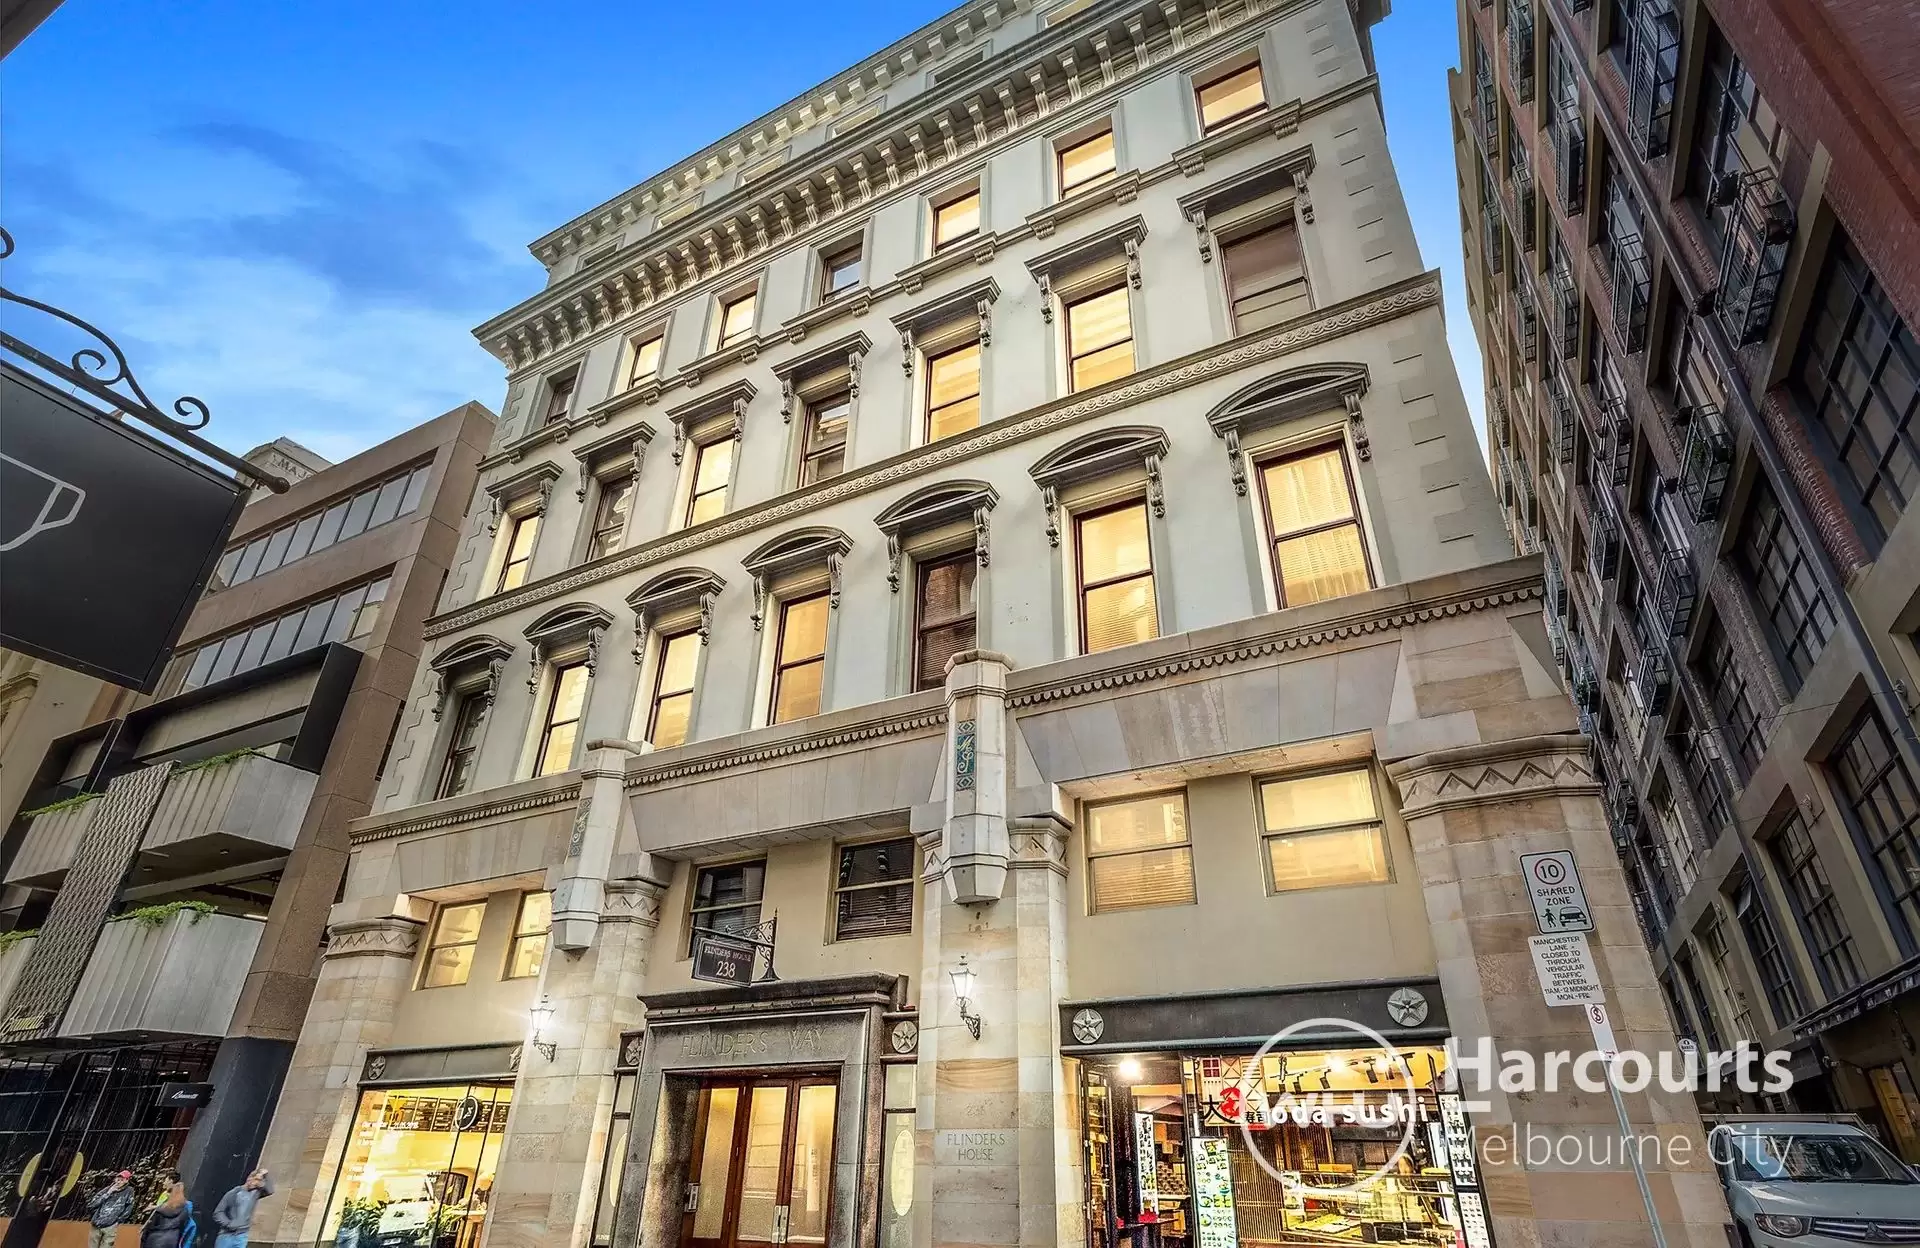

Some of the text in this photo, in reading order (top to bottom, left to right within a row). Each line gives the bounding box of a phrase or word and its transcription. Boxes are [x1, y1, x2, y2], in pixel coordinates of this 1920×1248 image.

[1540, 864, 1559, 879] 10
[1536, 886, 1576, 897] SHARED
[1546, 896, 1572, 906] ZONE
[1533, 936, 1581, 946] MANCHESTER
[704, 945, 731, 958] FLINDERS
[1541, 951, 1569, 959] CLOSED
[1546, 957, 1581, 966] THROUGH
[716, 960, 736, 978] 238
[1545, 964, 1585, 973] VEHICULAR
[1552, 971, 1582, 980] TRAFFIC
[1552, 978, 1587, 987] BETWEEN
[1569, 984, 1600, 993] MIDNIGHT
[680, 1027, 827, 1058] FLINDERS WAY
[1342, 1095, 1429, 1124] sushi
[947, 1133, 1006, 1146] FLINDERS
[958, 1148, 994, 1161] HOUSE
